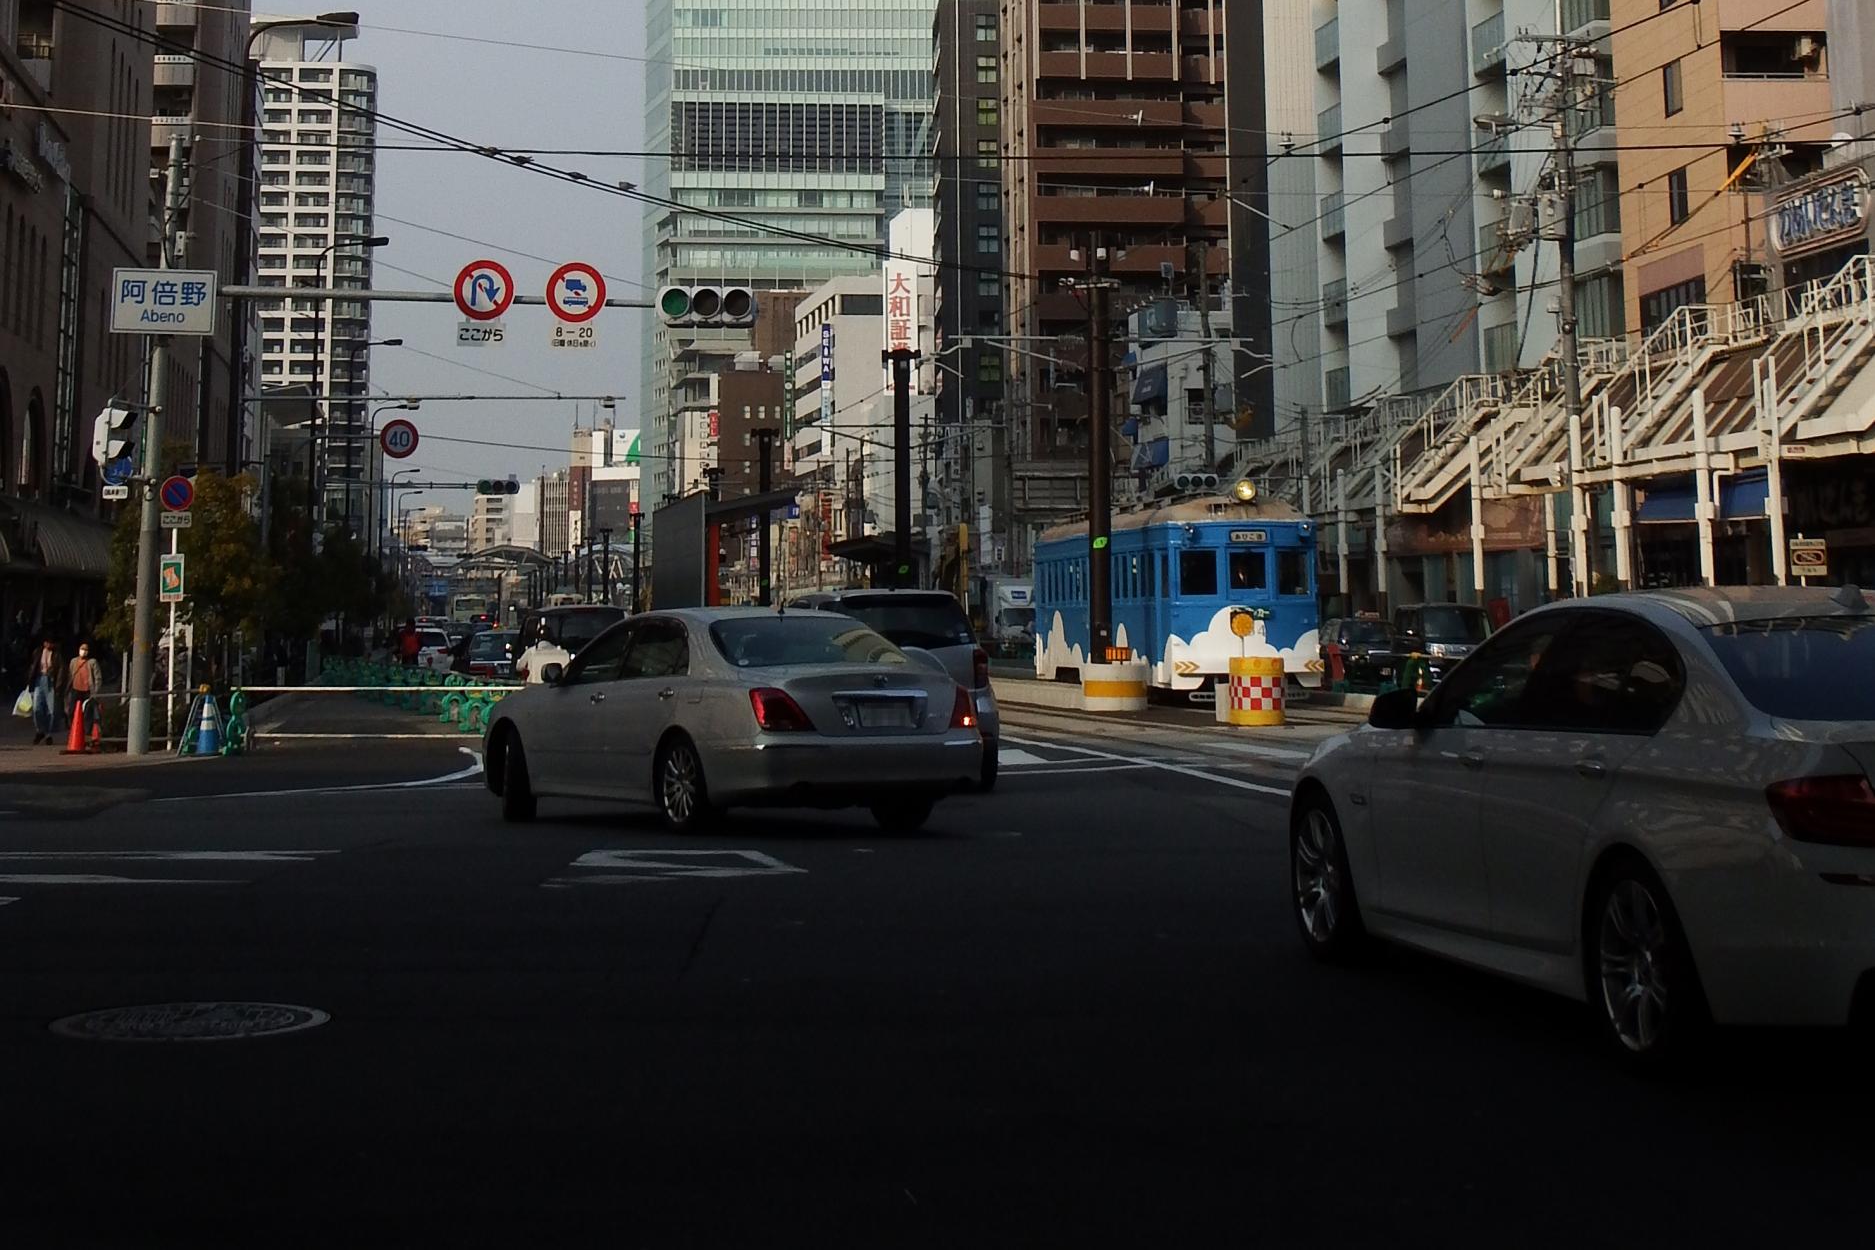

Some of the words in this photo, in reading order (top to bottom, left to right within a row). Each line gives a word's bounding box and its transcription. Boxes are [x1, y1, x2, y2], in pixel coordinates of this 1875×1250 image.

[120, 279, 207, 307] 阿倍野
[140, 309, 185, 323] Abeno
[459, 327, 504, 342] ここから
[822, 330, 830, 373] SEIWA
[389, 430, 410, 447] 40
